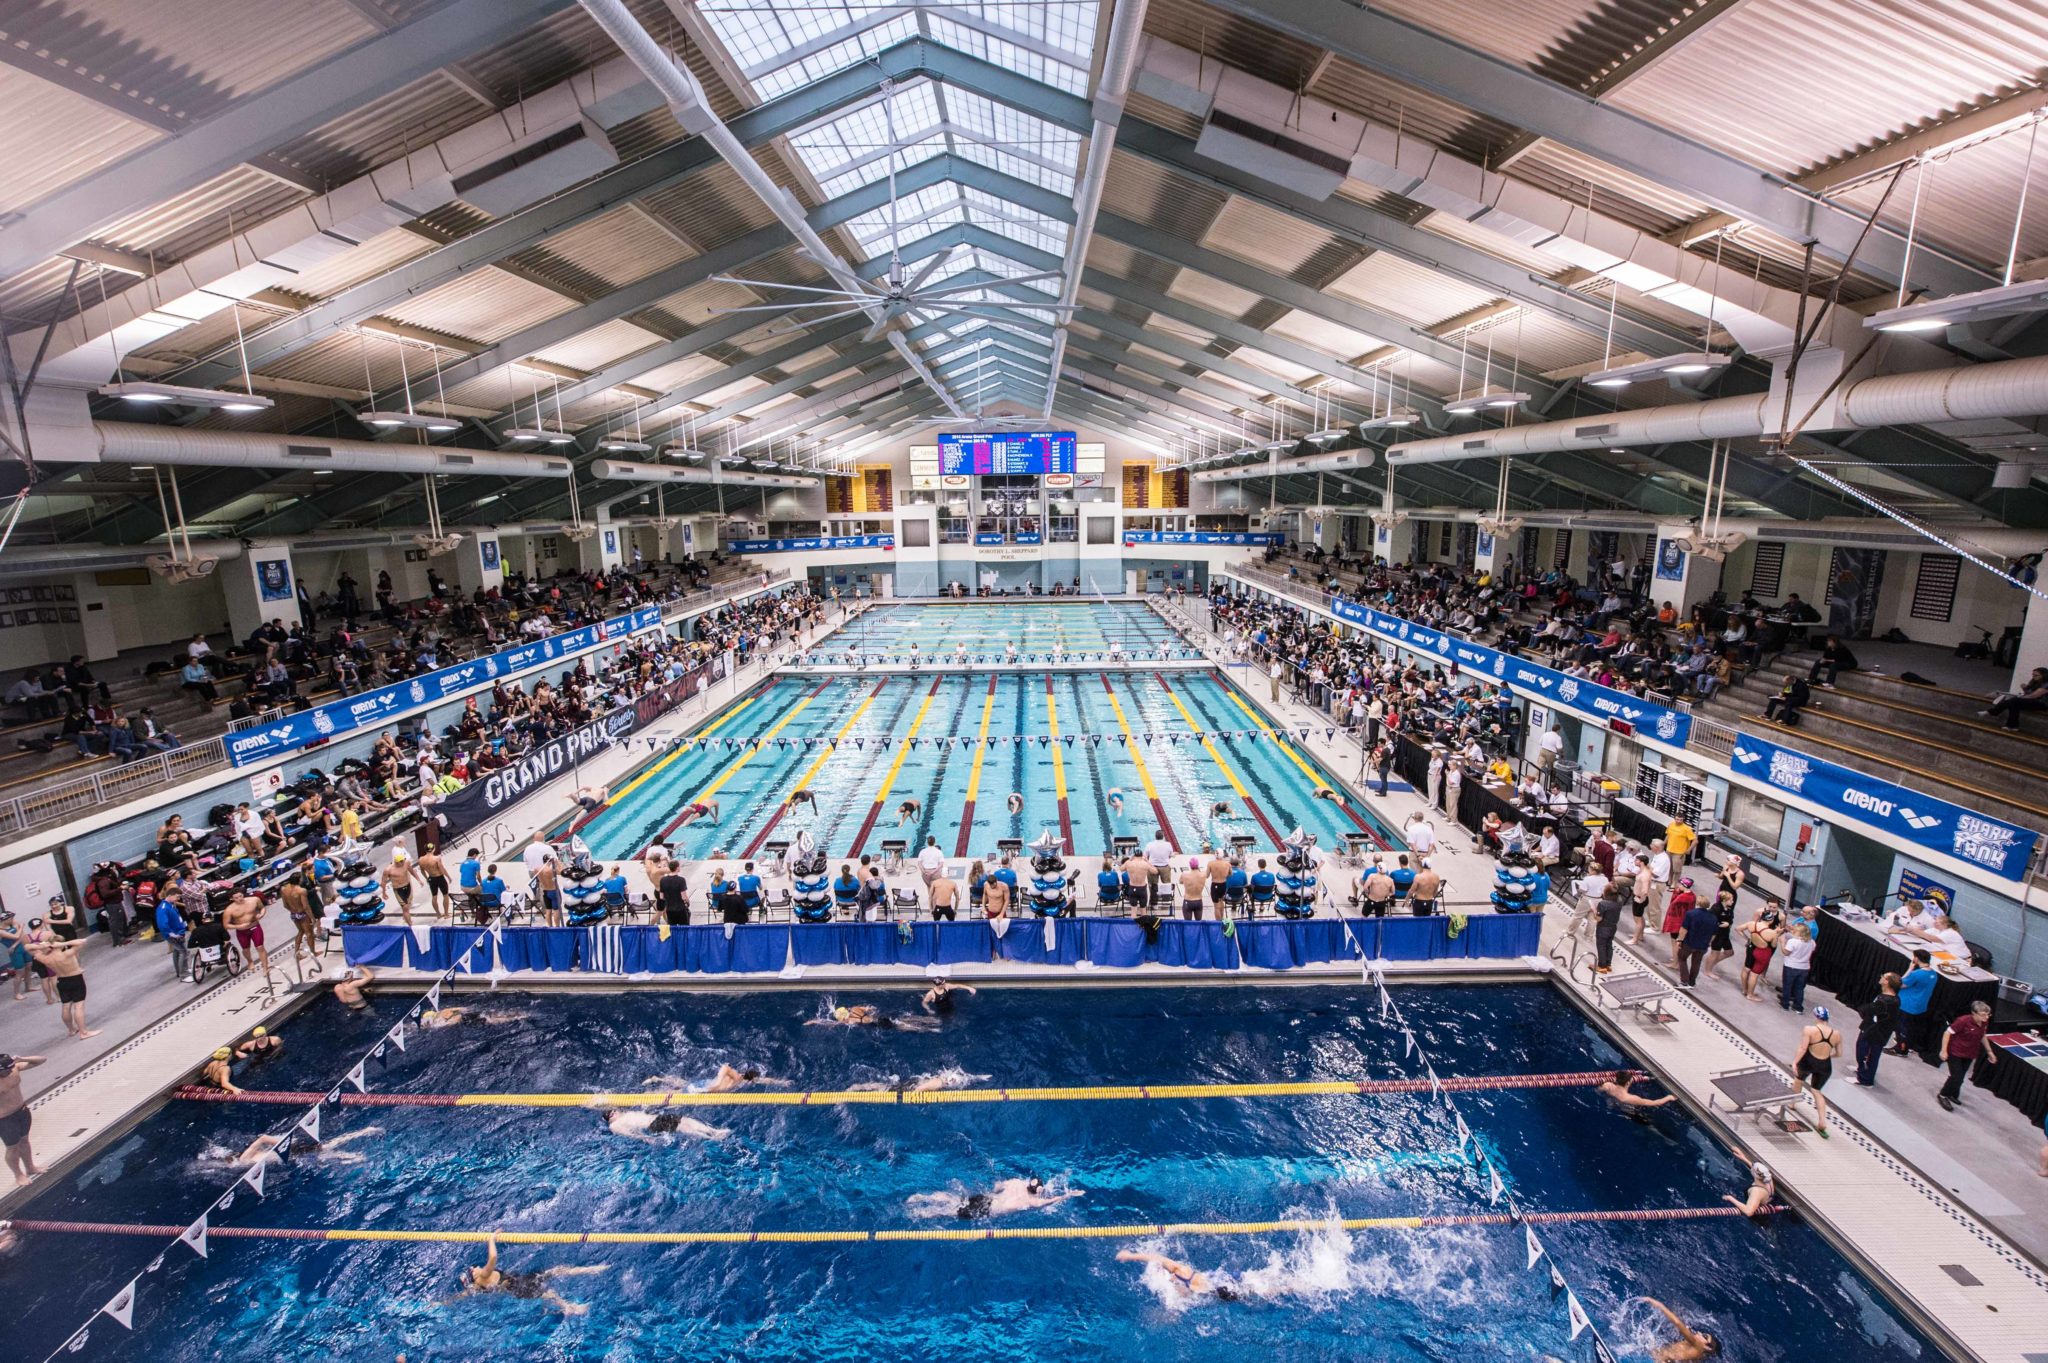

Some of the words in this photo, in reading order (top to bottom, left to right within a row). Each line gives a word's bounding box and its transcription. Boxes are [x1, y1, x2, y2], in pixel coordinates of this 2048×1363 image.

[350, 699, 377, 715] arena
[1594, 697, 1620, 714] arena
[232, 734, 270, 753] arena
[485, 742, 564, 808] GRAND
[566, 718, 610, 762] PRIX
[608, 710, 634, 735] Series
[1772, 750, 1808, 770] SHARK
[1768, 769, 1806, 792] TANK
[1842, 788, 1892, 817] arena
[1958, 814, 2015, 840] SHARK
[1953, 834, 2008, 870] TANK
[1904, 870, 1918, 880] Deck
